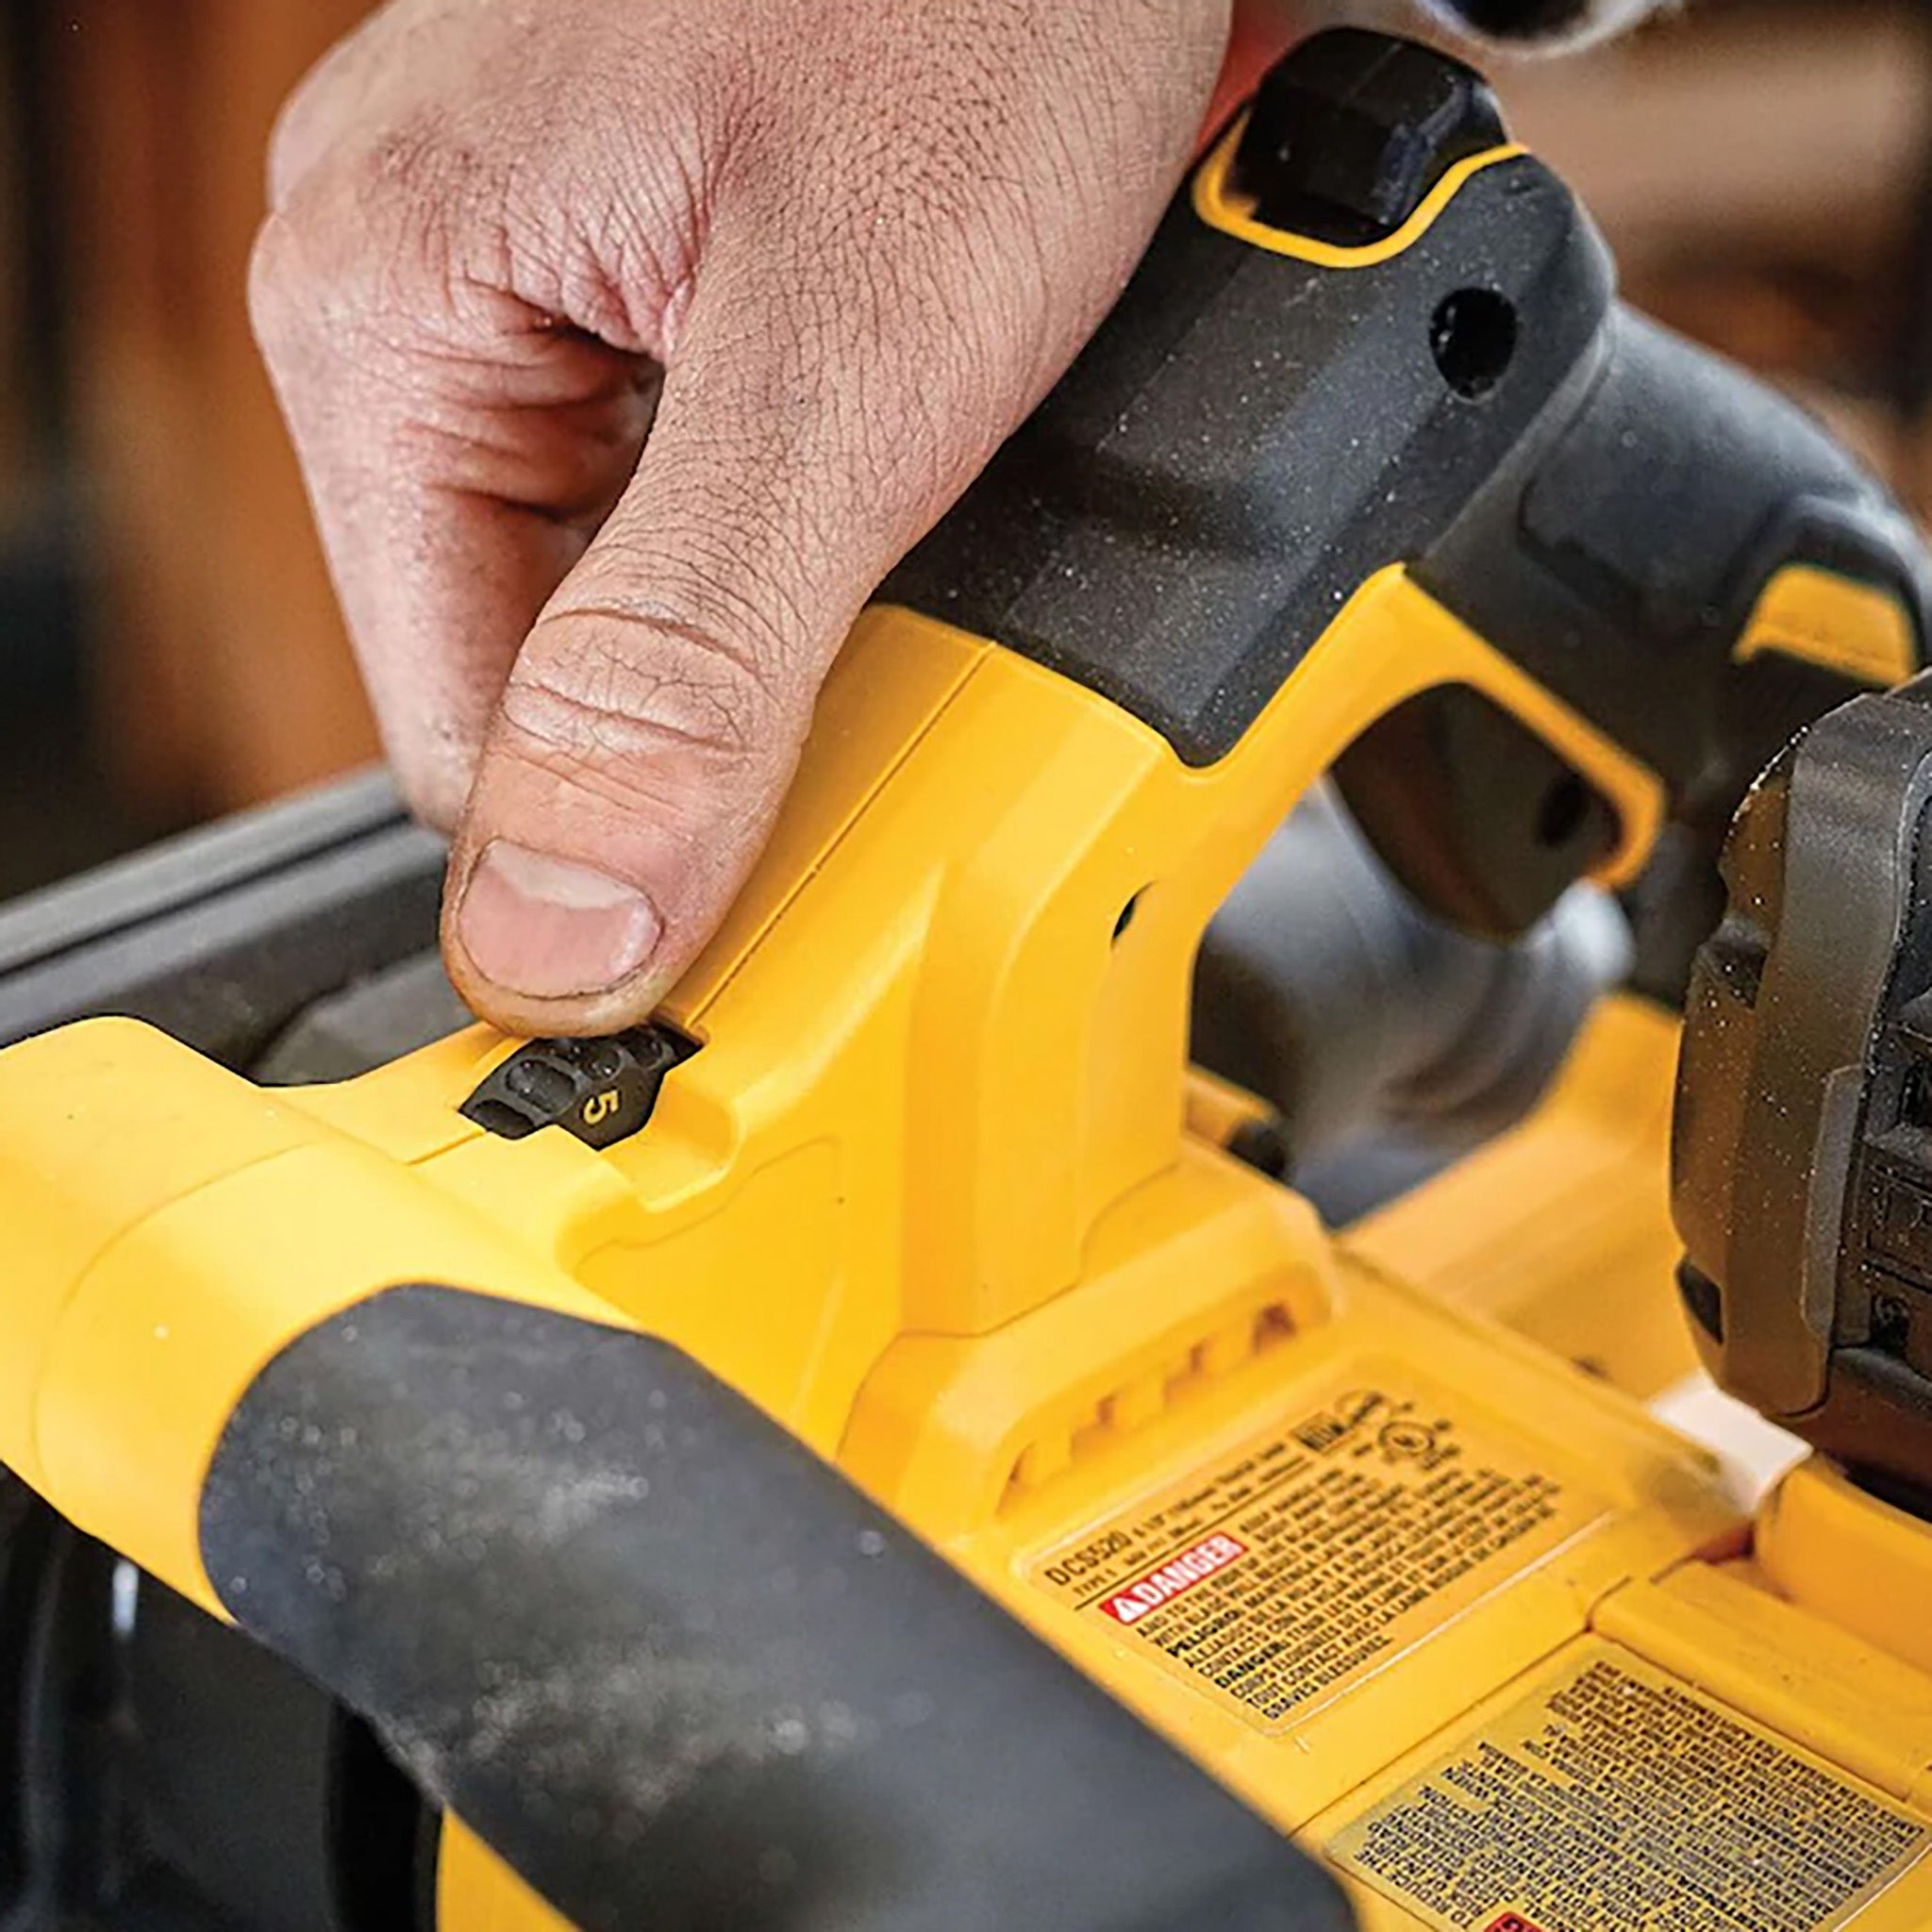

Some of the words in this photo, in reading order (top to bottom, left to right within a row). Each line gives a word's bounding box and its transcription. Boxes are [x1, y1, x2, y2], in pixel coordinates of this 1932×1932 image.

[582, 1089, 620, 1124] 5
[1041, 1526, 1135, 1588] DCS520
[1128, 1531, 1244, 1607] DANGER
[1291, 1599, 1318, 1617] LA
[1163, 1604, 1247, 1658] PELIGRO:
[1179, 1620, 1254, 1669] ALEJADOS
[1246, 1609, 1272, 1626] DE
[1264, 1598, 1291, 1615] LA
[1211, 1635, 1292, 1690] DANGER:
[1277, 1641, 1346, 1688] CONTACT
[1259, 1679, 1320, 1721] GRAVES
[1351, 1847, 1391, 1874] THE
[1384, 1869, 1454, 1915] REDUCE
[1420, 1873, 1449, 1893] OF
[1443, 1889, 1487, 1918] RISK
[1447, 1908, 1476, 1929] TO
